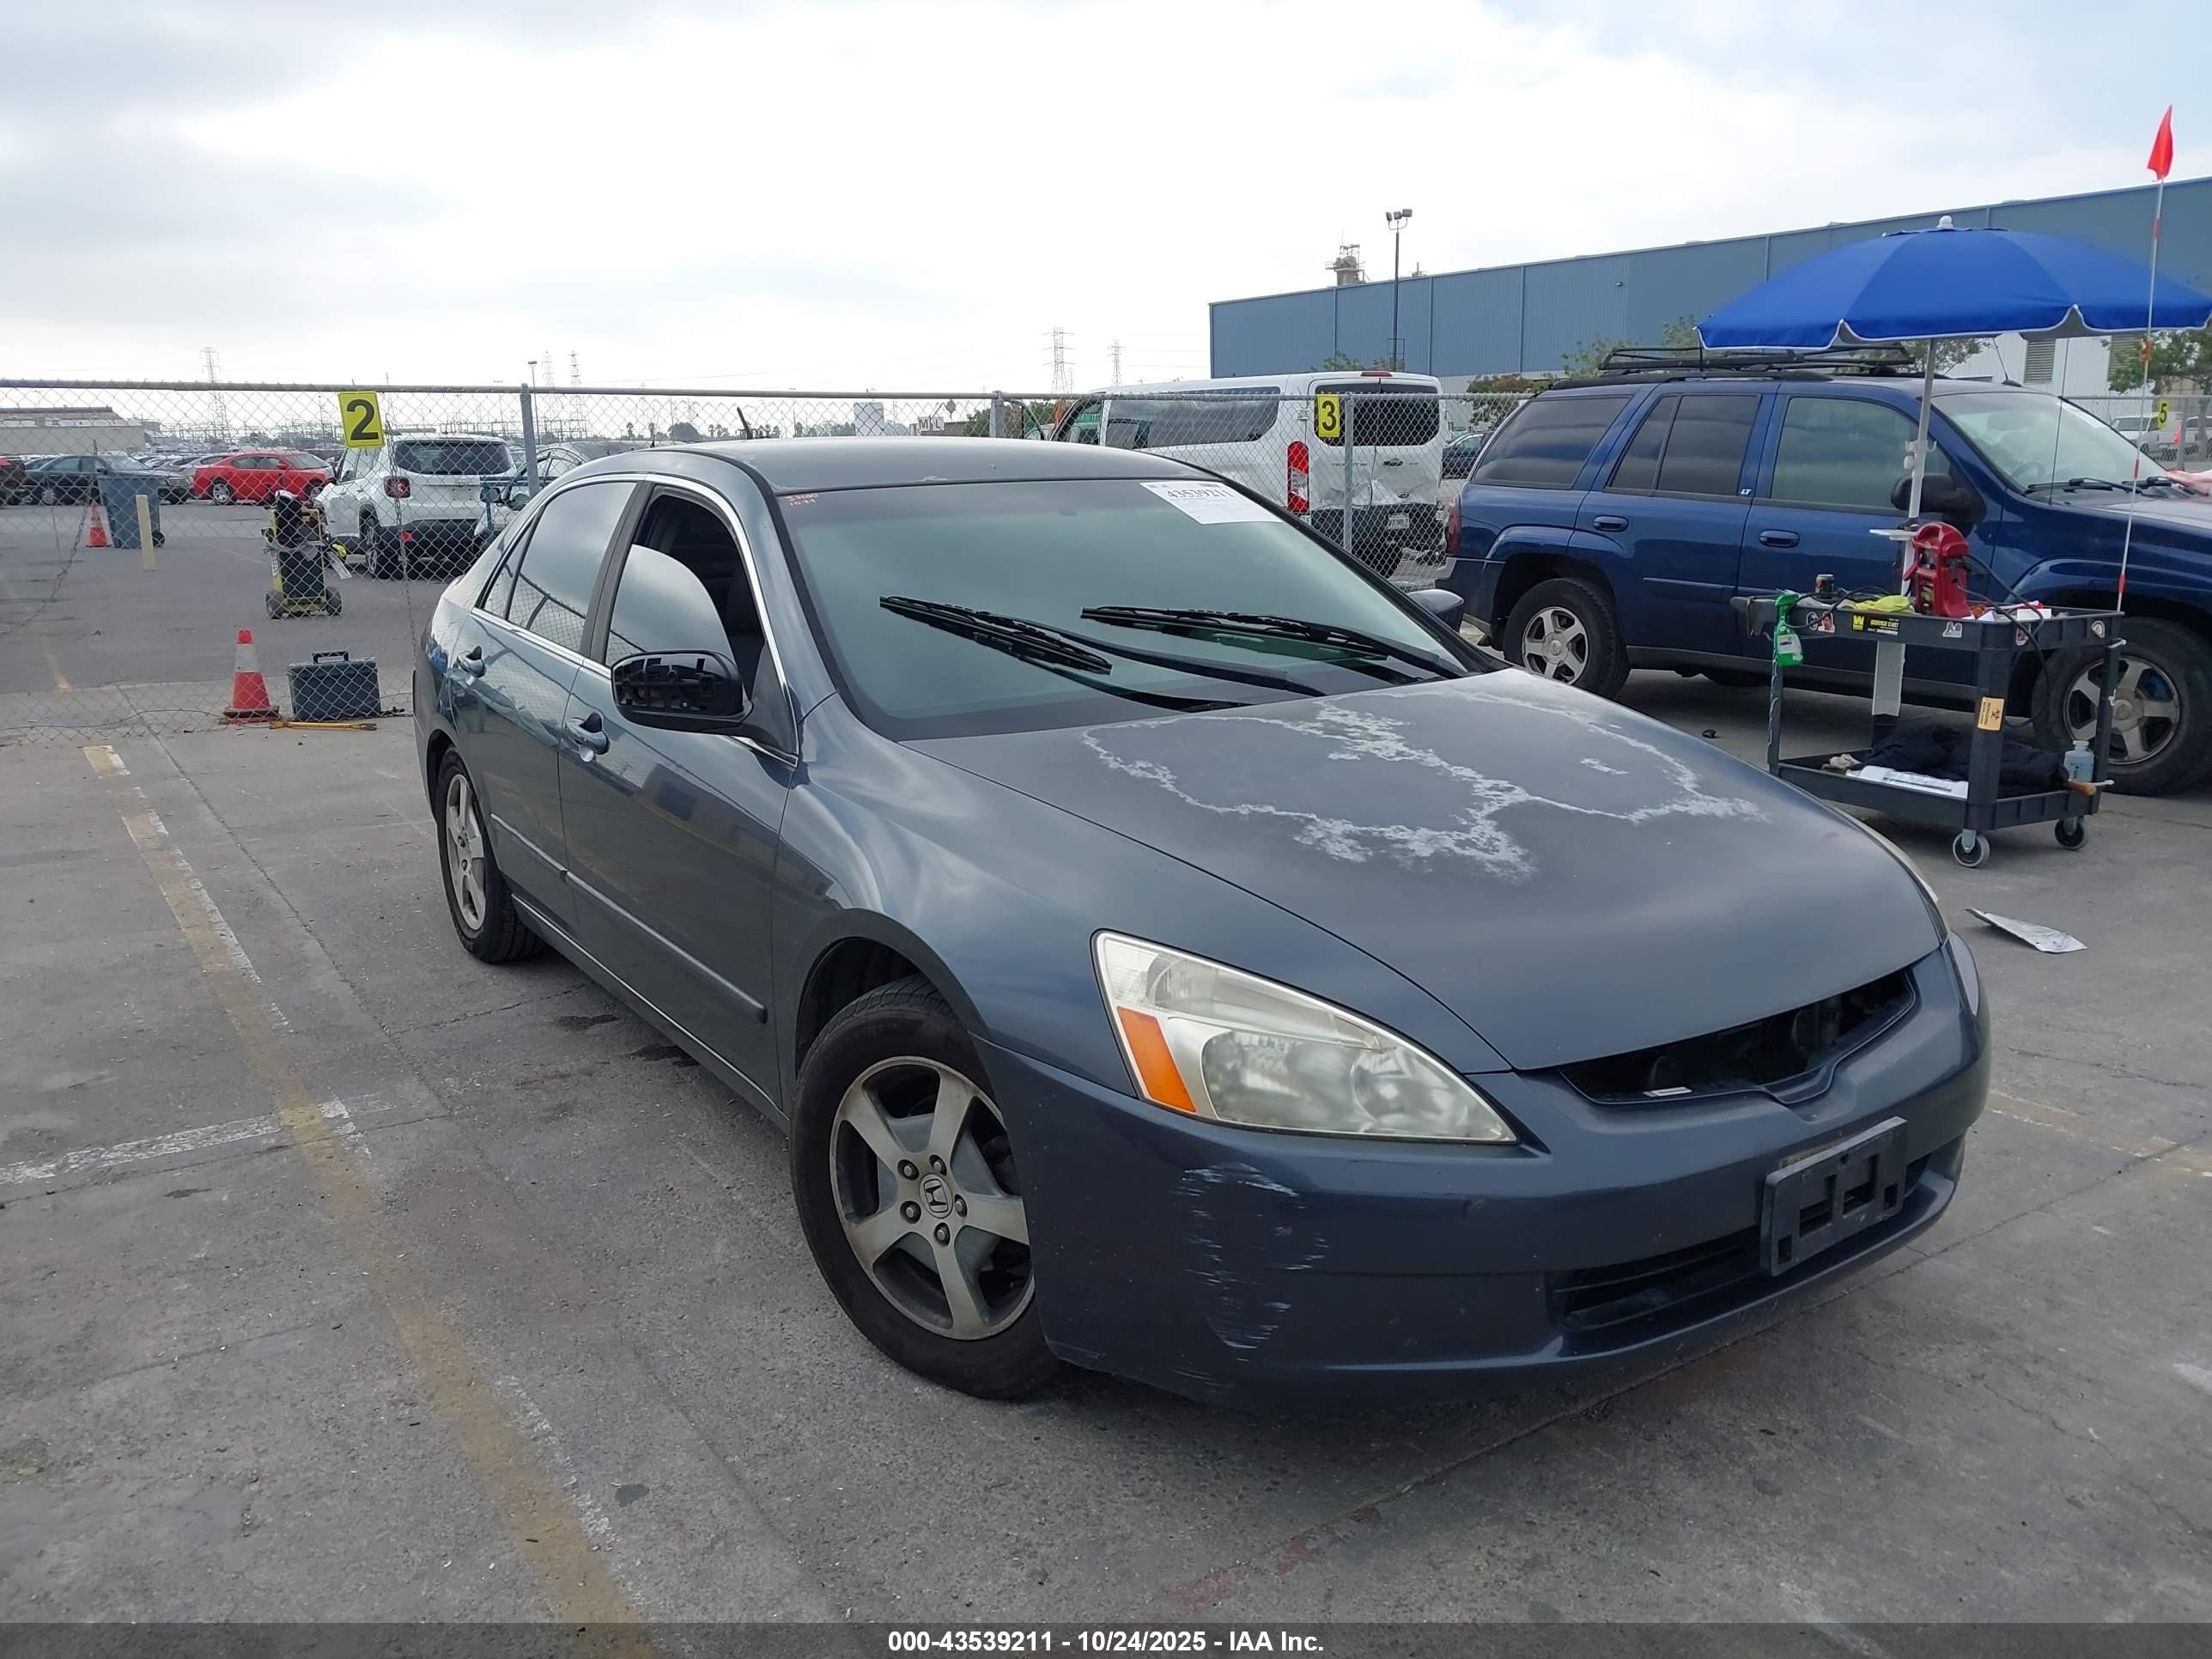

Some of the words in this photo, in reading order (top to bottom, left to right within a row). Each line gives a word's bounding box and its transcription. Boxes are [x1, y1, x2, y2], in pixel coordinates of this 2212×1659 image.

[346, 398, 379, 441] 2
[1322, 400, 1337, 431] 3
[2160, 403, 2167, 423] 5
[1167, 489, 1235, 498] 43539211
